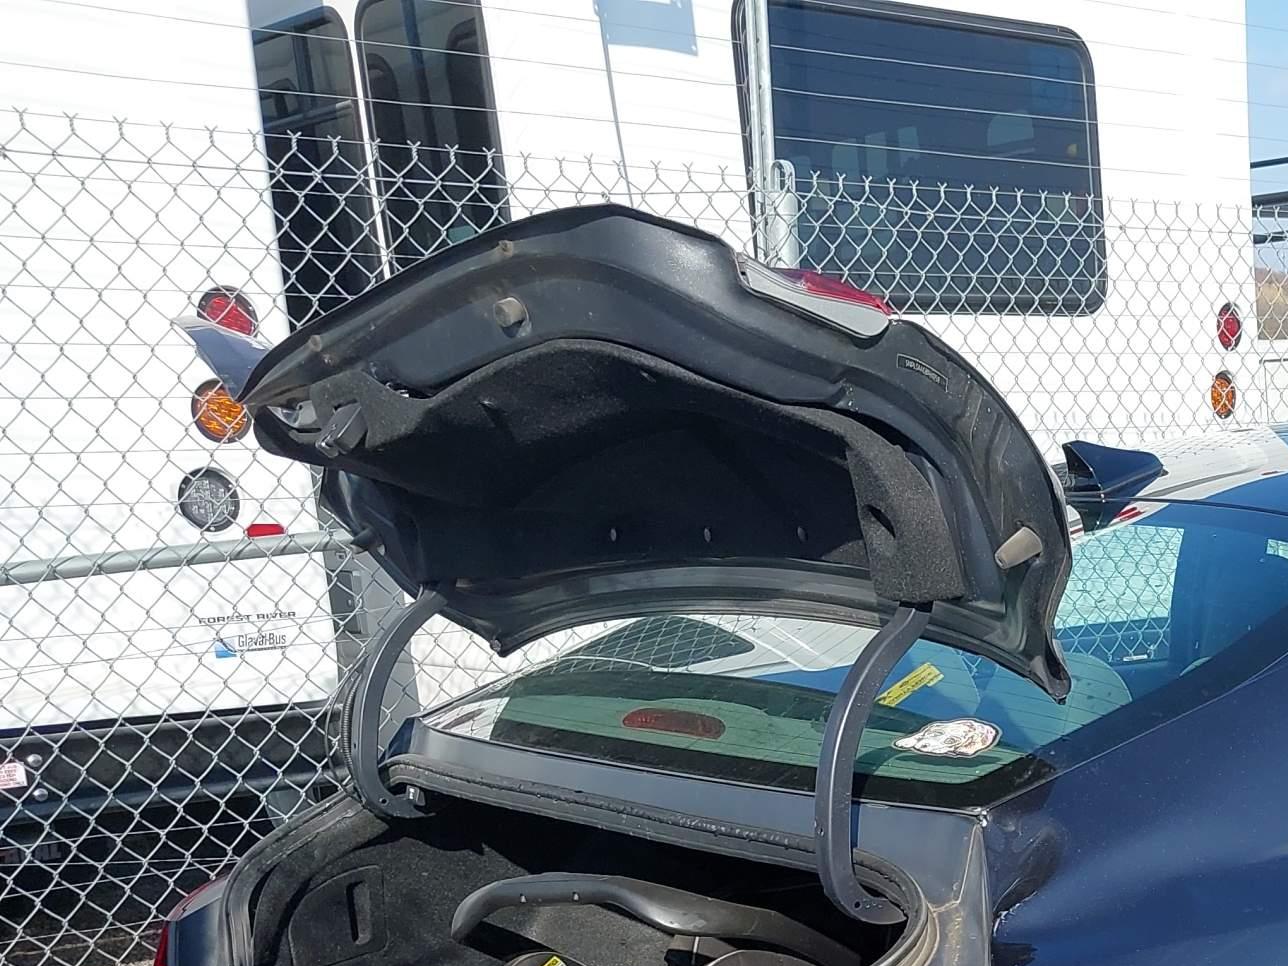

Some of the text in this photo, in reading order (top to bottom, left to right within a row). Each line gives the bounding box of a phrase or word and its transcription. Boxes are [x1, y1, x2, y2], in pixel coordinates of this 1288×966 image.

[199, 611, 296, 624] FOREST RIVER
[268, 632, 287, 645] Bus
